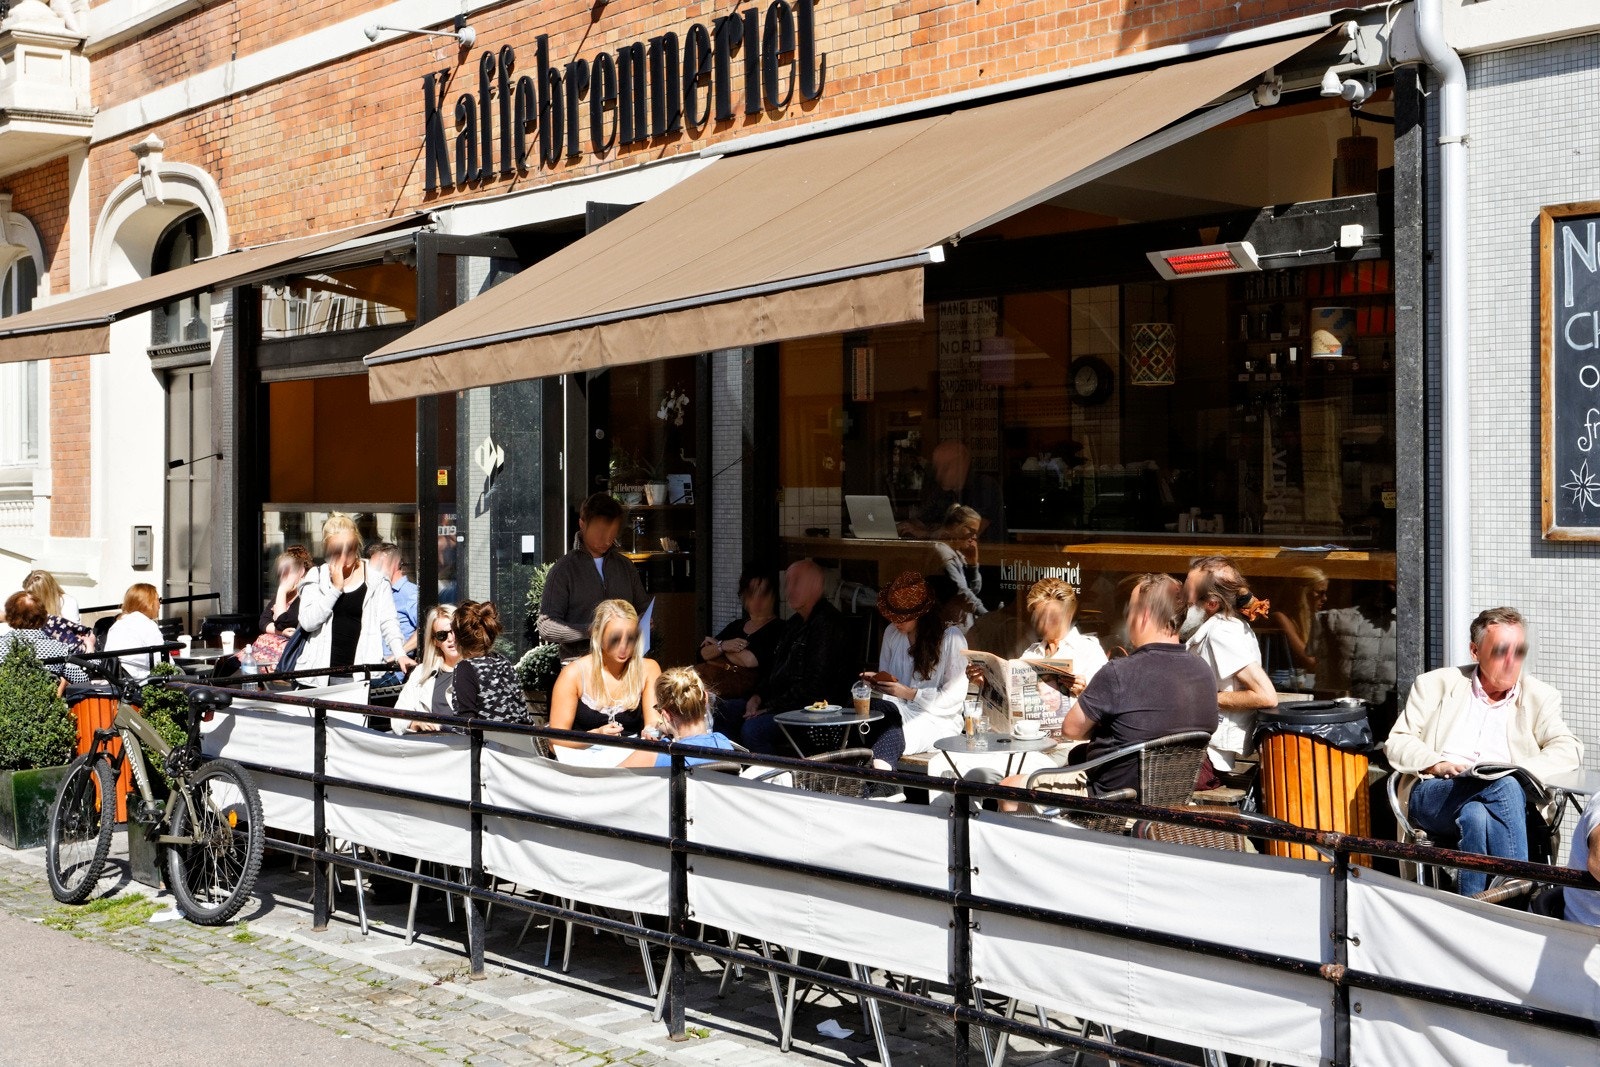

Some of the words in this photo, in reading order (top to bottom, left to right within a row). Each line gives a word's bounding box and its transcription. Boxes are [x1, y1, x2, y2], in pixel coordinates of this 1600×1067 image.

[422, 0, 827, 192] Kaffebrenneriet
[1562, 222, 1600, 308] N
[940, 340, 982, 354] NORD
[1000, 559, 1082, 585] Kaffebrenneriet
